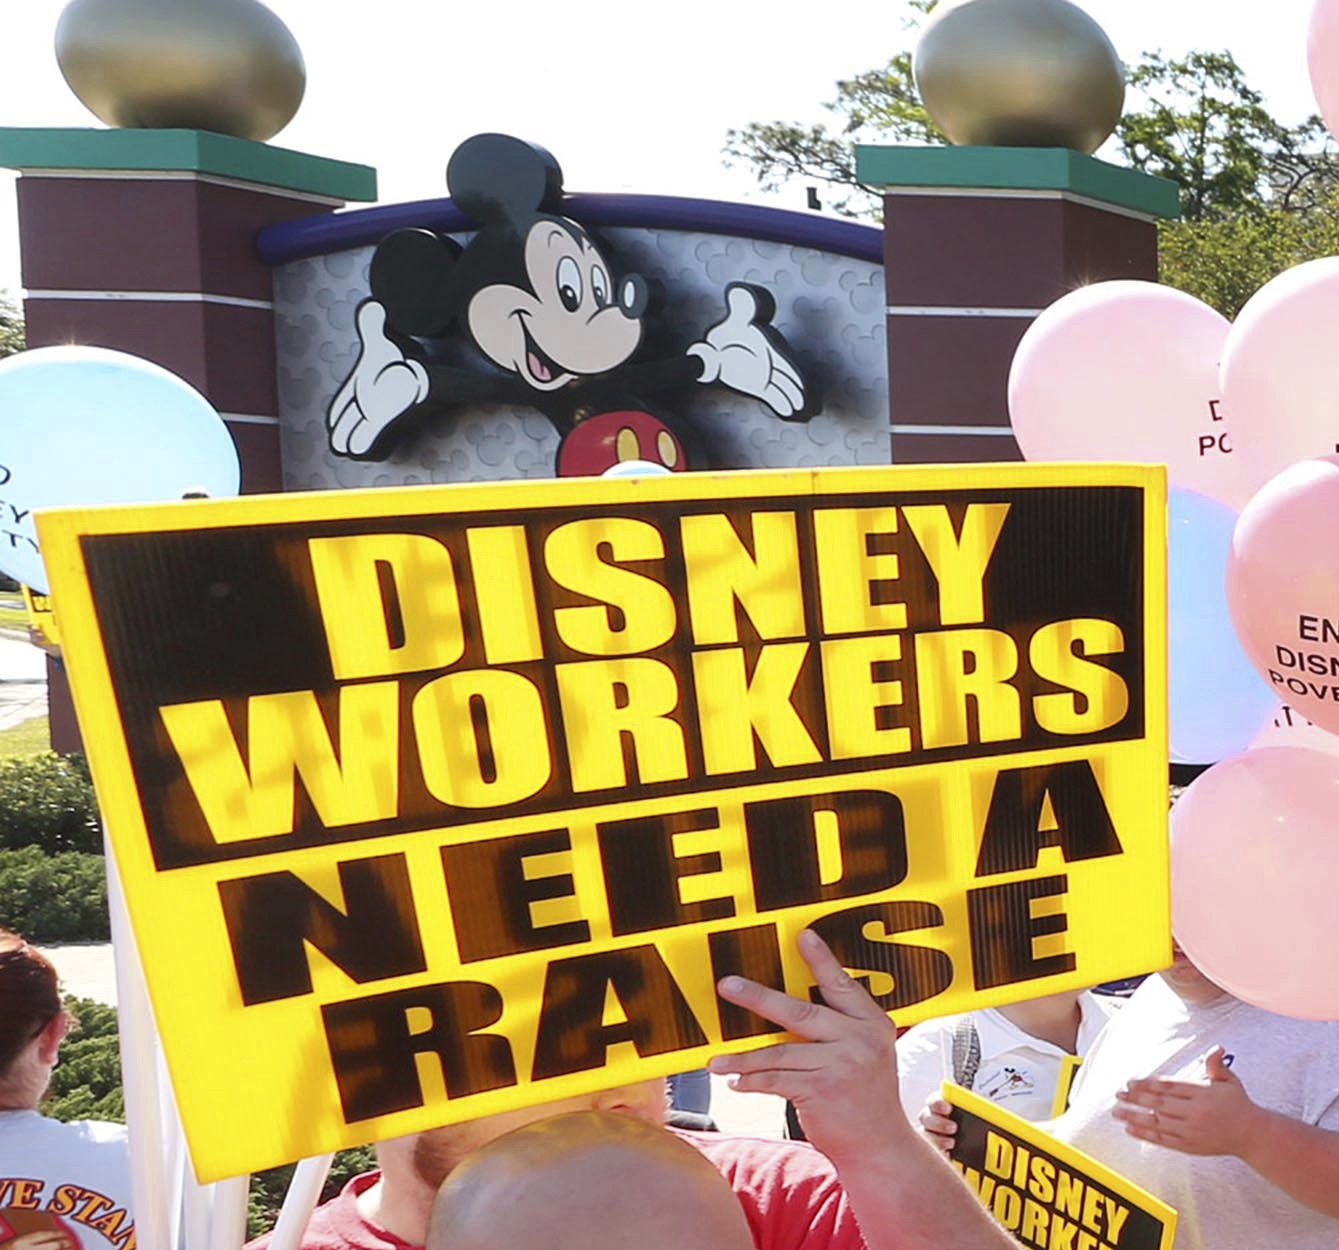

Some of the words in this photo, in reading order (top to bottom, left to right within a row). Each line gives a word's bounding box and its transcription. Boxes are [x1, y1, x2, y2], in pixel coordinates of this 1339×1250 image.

[308, 503, 1011, 681] DISNEY
[159, 618, 1130, 844] WORKERS
[217, 788, 910, 1006] NEED
[974, 759, 1125, 877] A
[321, 873, 1077, 1124] RAISE
[984, 1130, 1130, 1246] DISNEY
